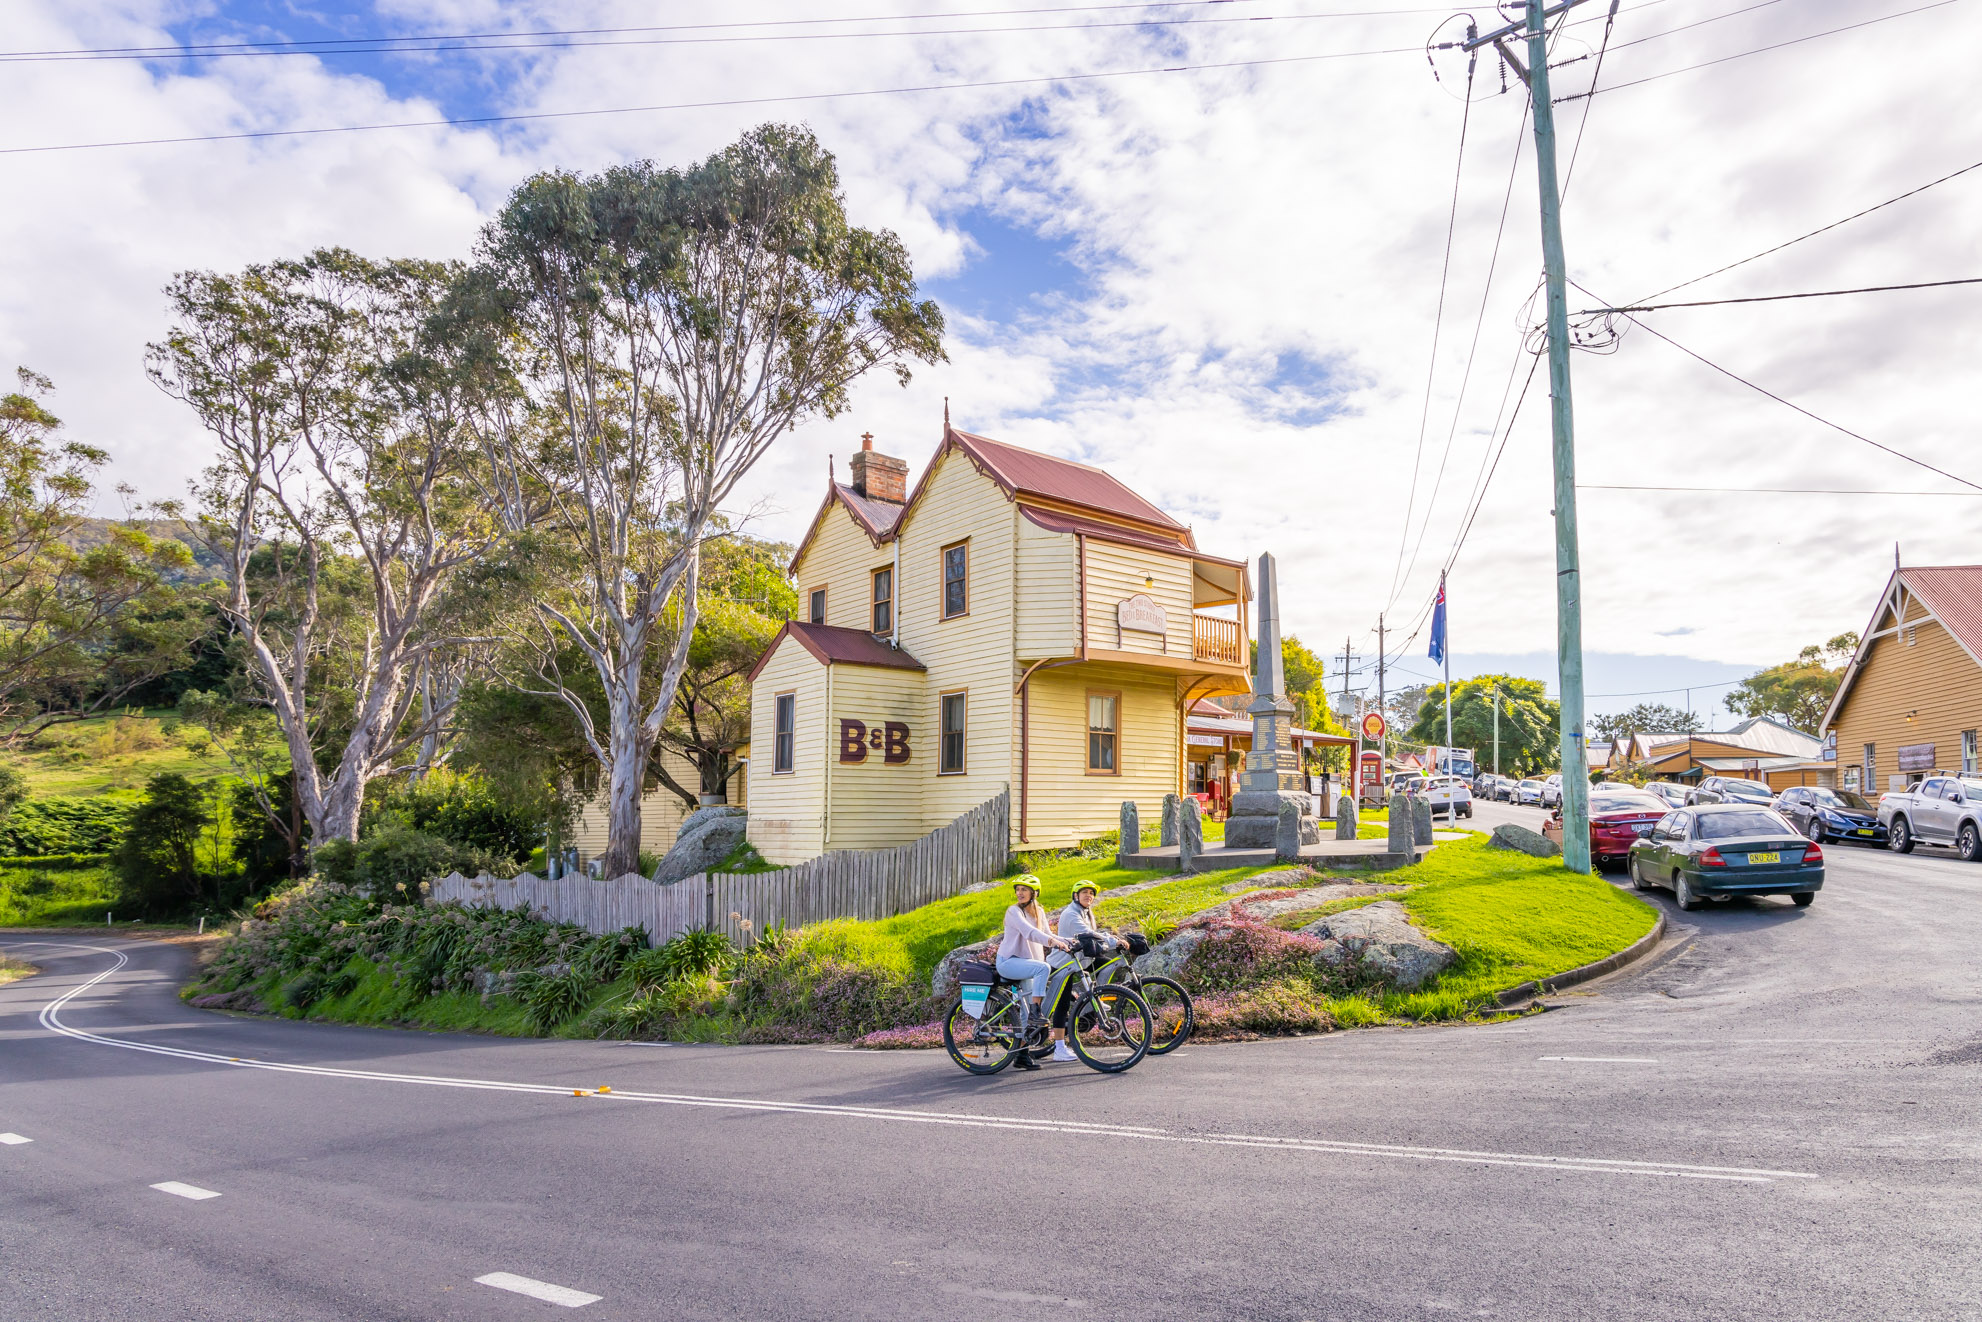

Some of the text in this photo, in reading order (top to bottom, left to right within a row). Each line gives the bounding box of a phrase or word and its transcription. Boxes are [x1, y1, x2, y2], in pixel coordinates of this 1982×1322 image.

[1122, 610, 1132, 624] BED
[1136, 609, 1163, 629] BREAKFAST
[839, 718, 912, 766] B&B
